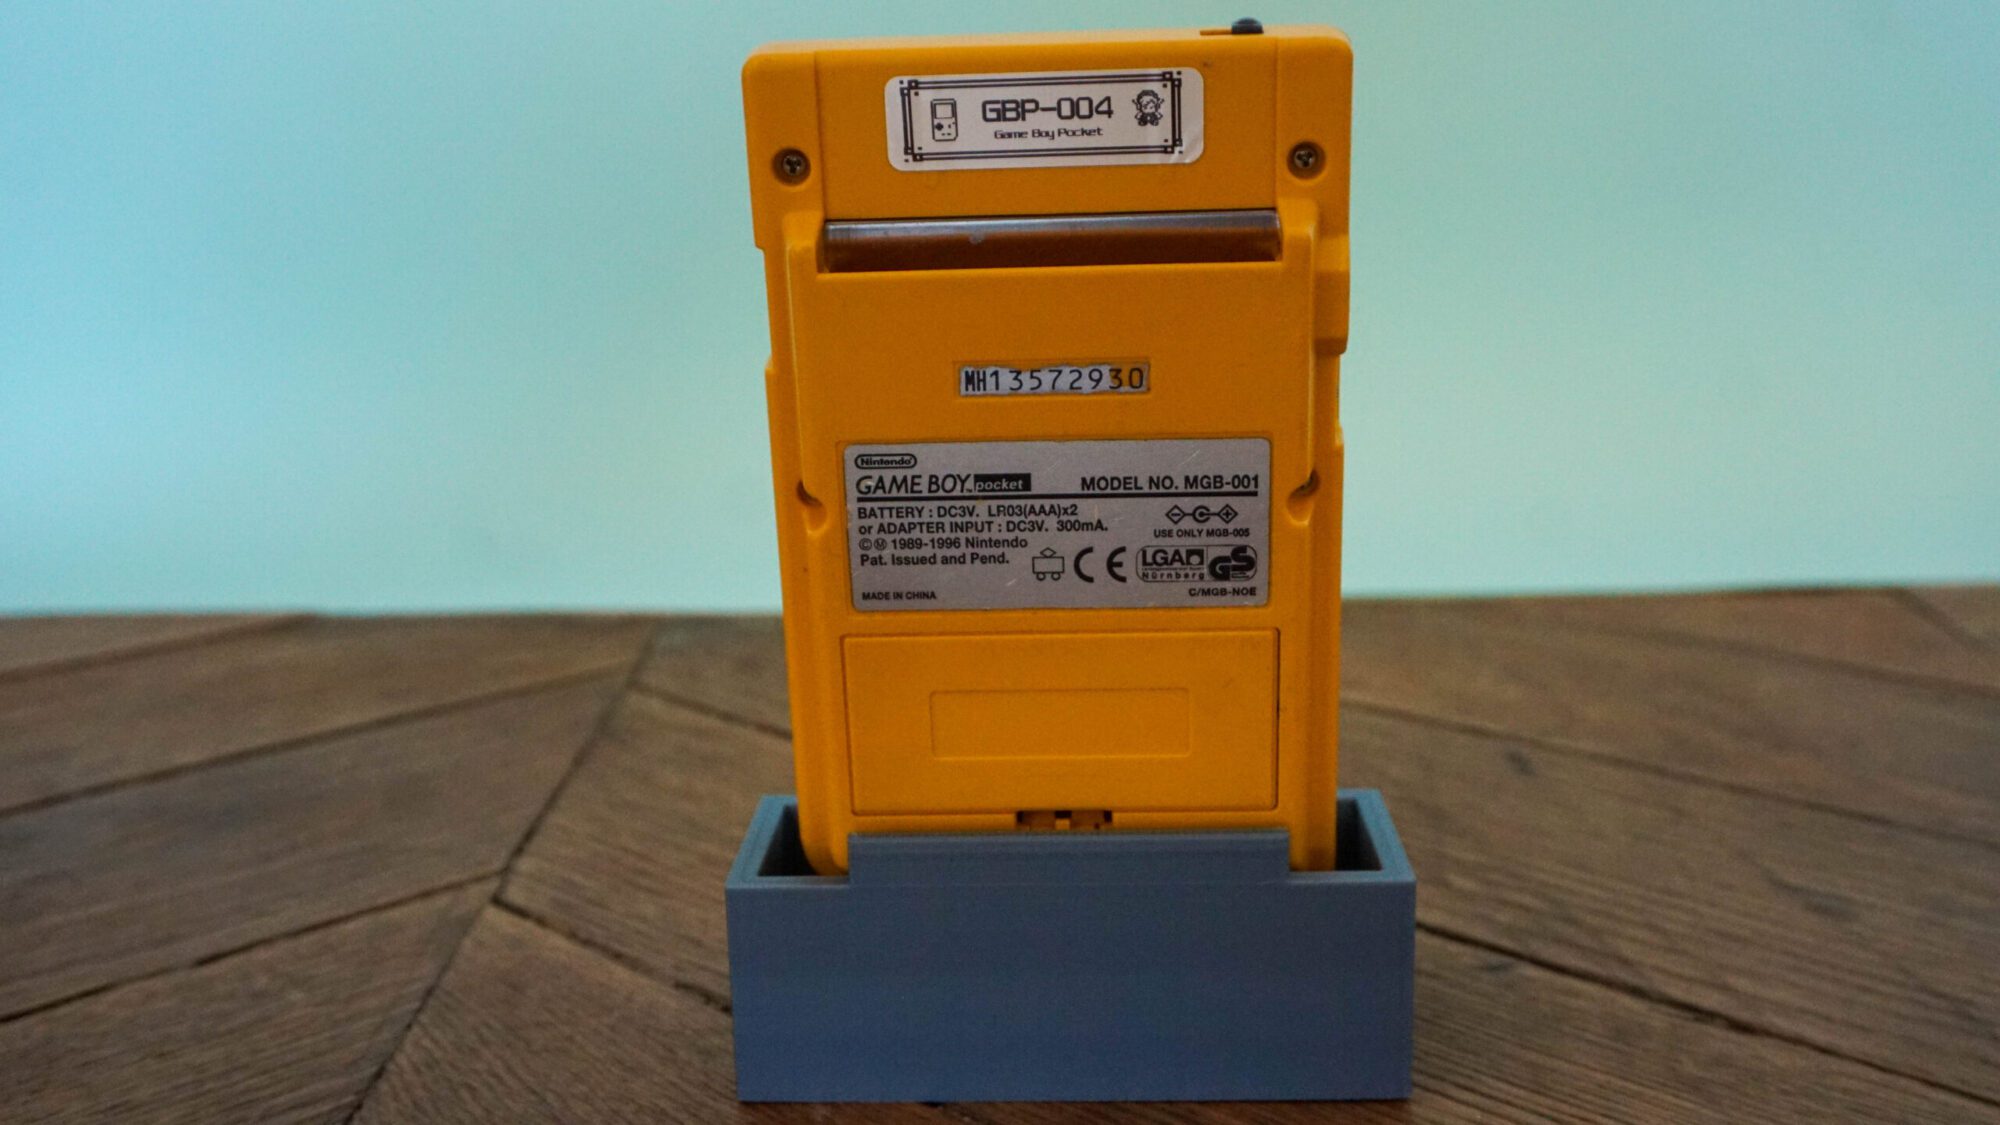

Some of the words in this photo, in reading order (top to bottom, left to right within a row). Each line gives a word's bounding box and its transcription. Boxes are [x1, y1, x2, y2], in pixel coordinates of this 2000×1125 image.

[981, 96, 1114, 122] GBP-004
[994, 130, 1028, 139] Game
[1032, 129, 1055, 140] Boy
[1058, 127, 1104, 137] Pocket
[965, 367, 1144, 391] MH13572930
[860, 457, 912, 466] Nintendo
[856, 475, 922, 494] GAME
[975, 480, 1023, 492] pocket
[1081, 476, 1143, 490] MODEL
[1149, 476, 1178, 489] NO.
[1184, 474, 1258, 489] MGB-001
[858, 507, 924, 519] BATTERY
[937, 506, 979, 518] DC3V.
[988, 504, 1078, 518] LR03(AAA)x2
[859, 526, 873, 535] or
[877, 523, 945, 535] ADAPTER
[950, 522, 994, 534] INPUT
[1006, 521, 1048, 533] DC3V.
[1056, 520, 1108, 532] 300mA.
[1154, 529, 1174, 538] USE
[1177, 529, 1203, 538] ONLY
[1206, 528, 1250, 537] MGB-005
[891, 537, 960, 549] 1989-1996
[965, 537, 1028, 549] Nintendo
[860, 554, 887, 566] Pat.
[892, 553, 936, 565] Issued
[941, 553, 966, 565] and
[970, 552, 1010, 564] Pend.
[1142, 549, 1186, 566] LGA
[862, 592, 890, 600] MADE
[893, 592, 902, 600] IN
[906, 591, 937, 600] CHINA
[1188, 587, 1257, 596] C/MGB-NOE
